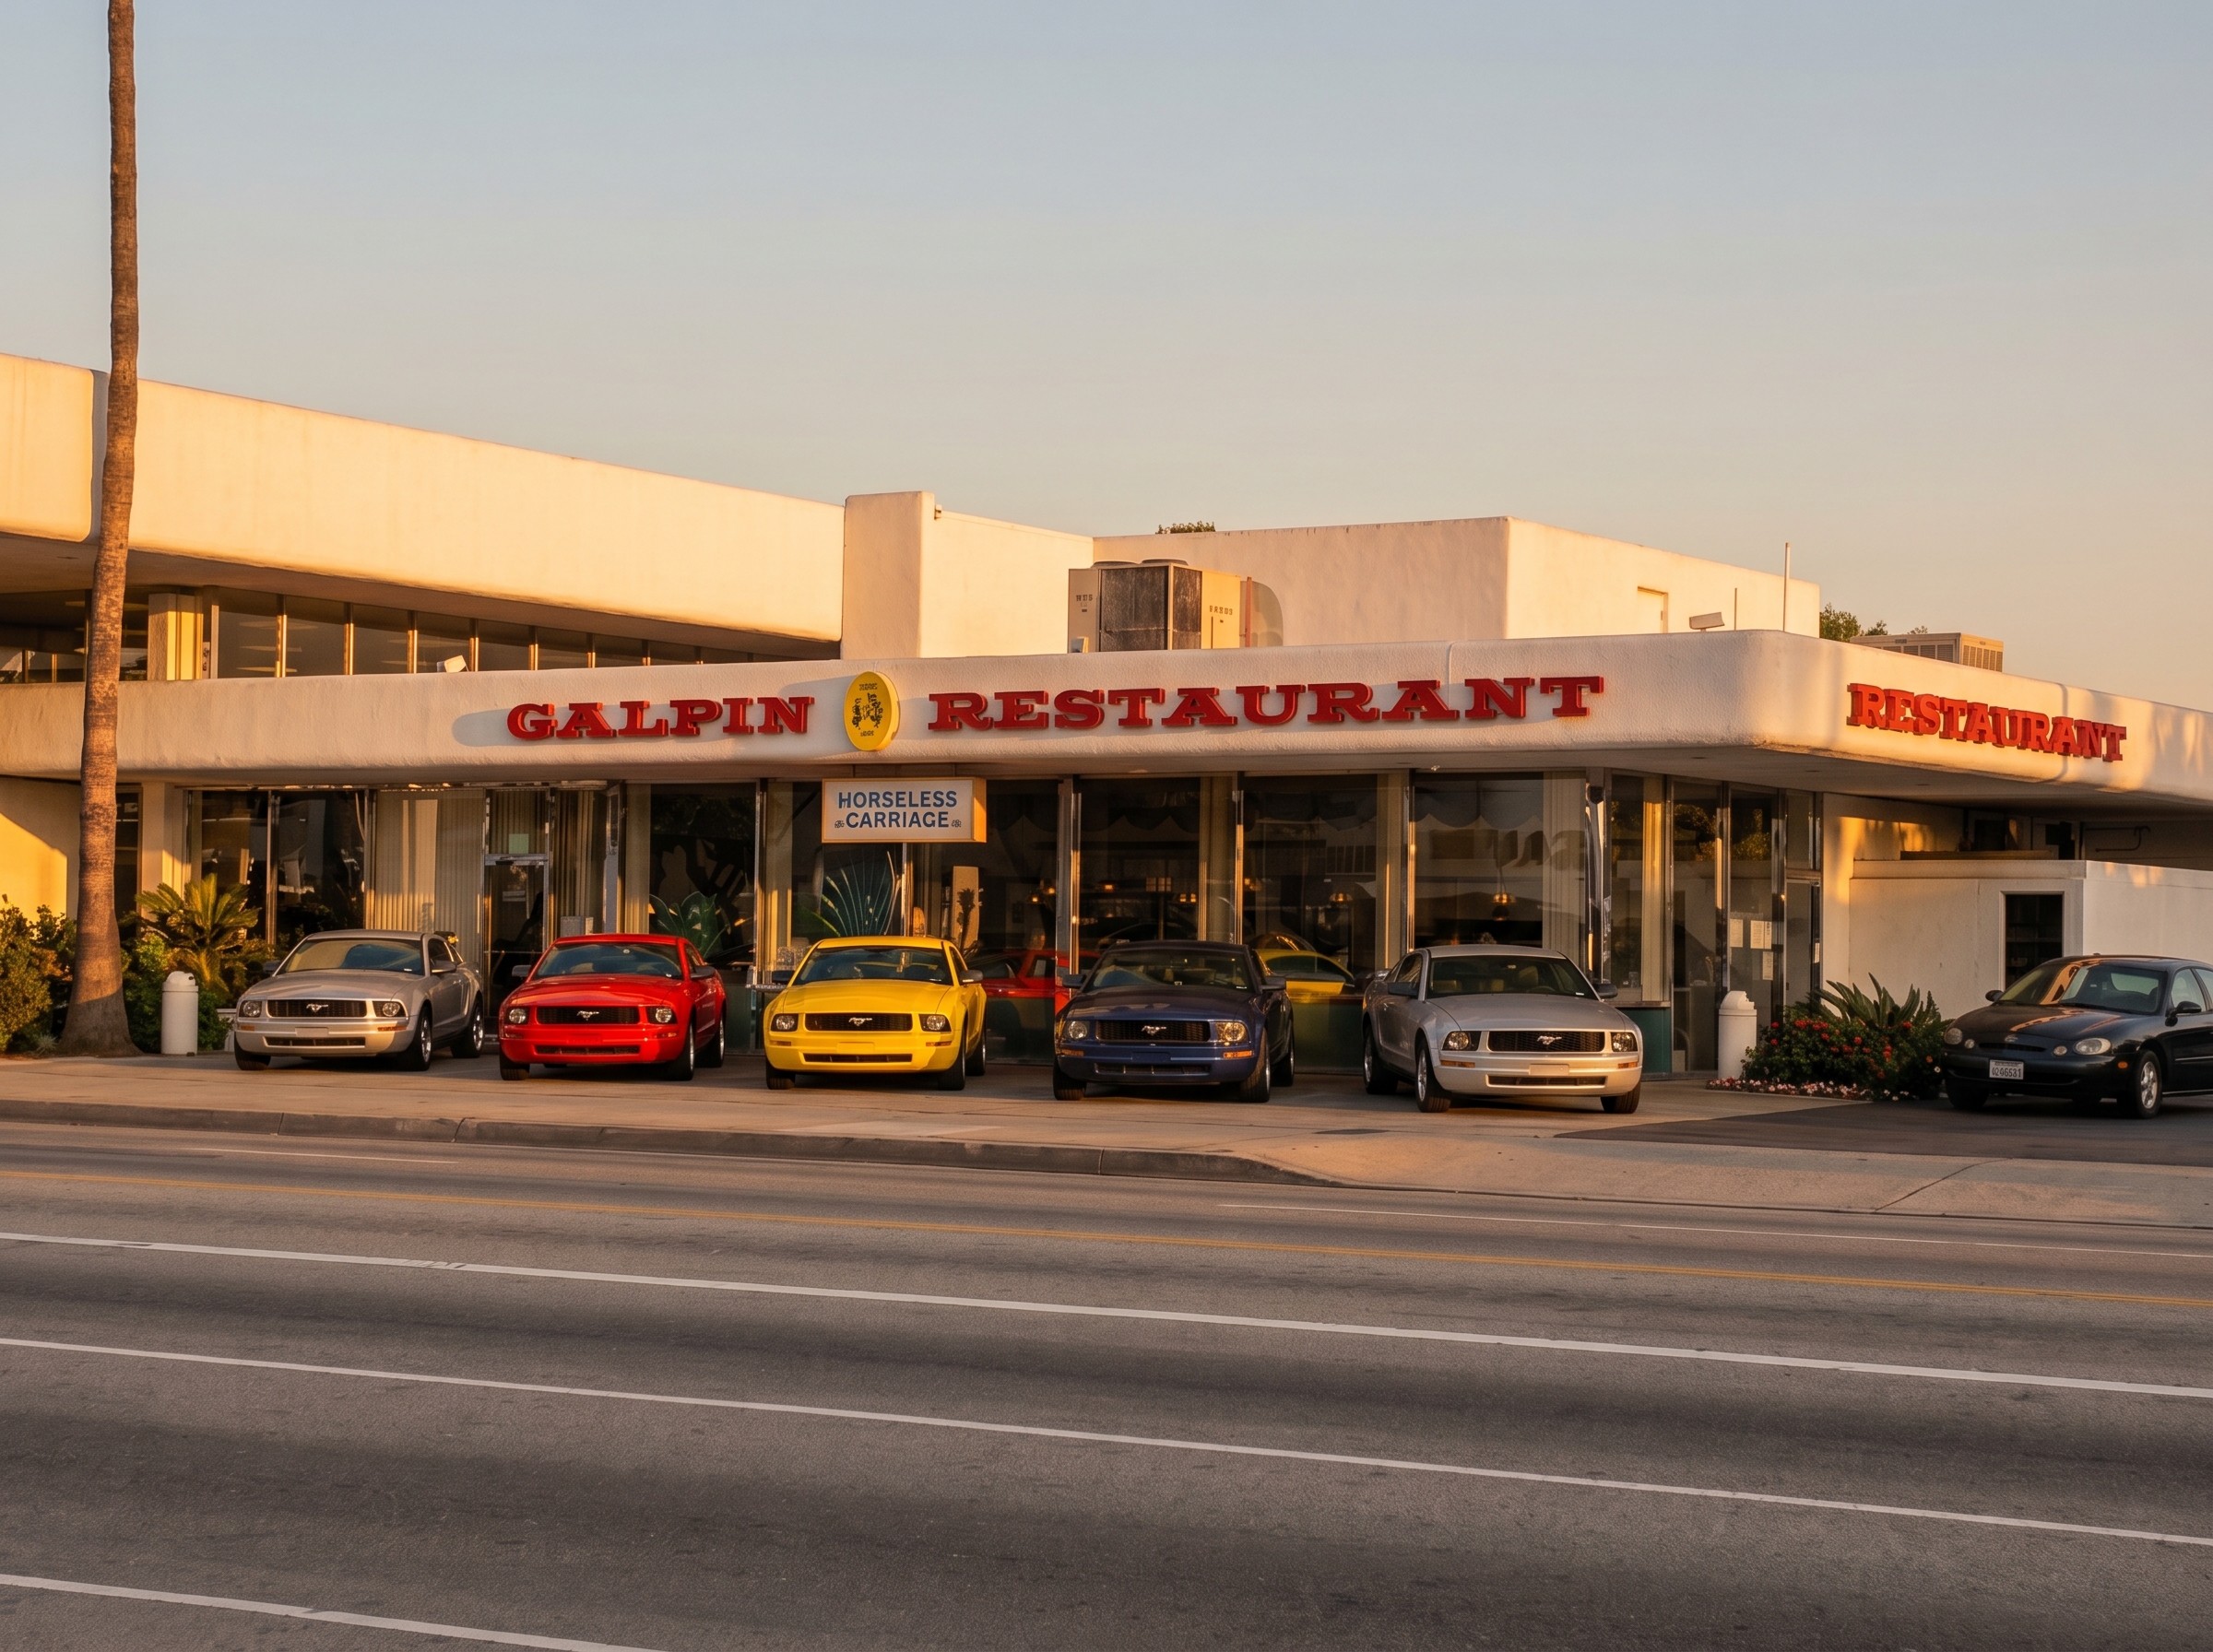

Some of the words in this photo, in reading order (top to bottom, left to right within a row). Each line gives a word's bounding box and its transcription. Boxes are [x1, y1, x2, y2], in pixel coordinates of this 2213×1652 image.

[507, 696, 814, 740] GALPIN
[928, 676, 1604, 730] RESTAURANT
[1847, 683, 2126, 761] RESTAURANT
[838, 791, 957, 808] HORSELESS
[846, 811, 949, 828] CARRIAGE
